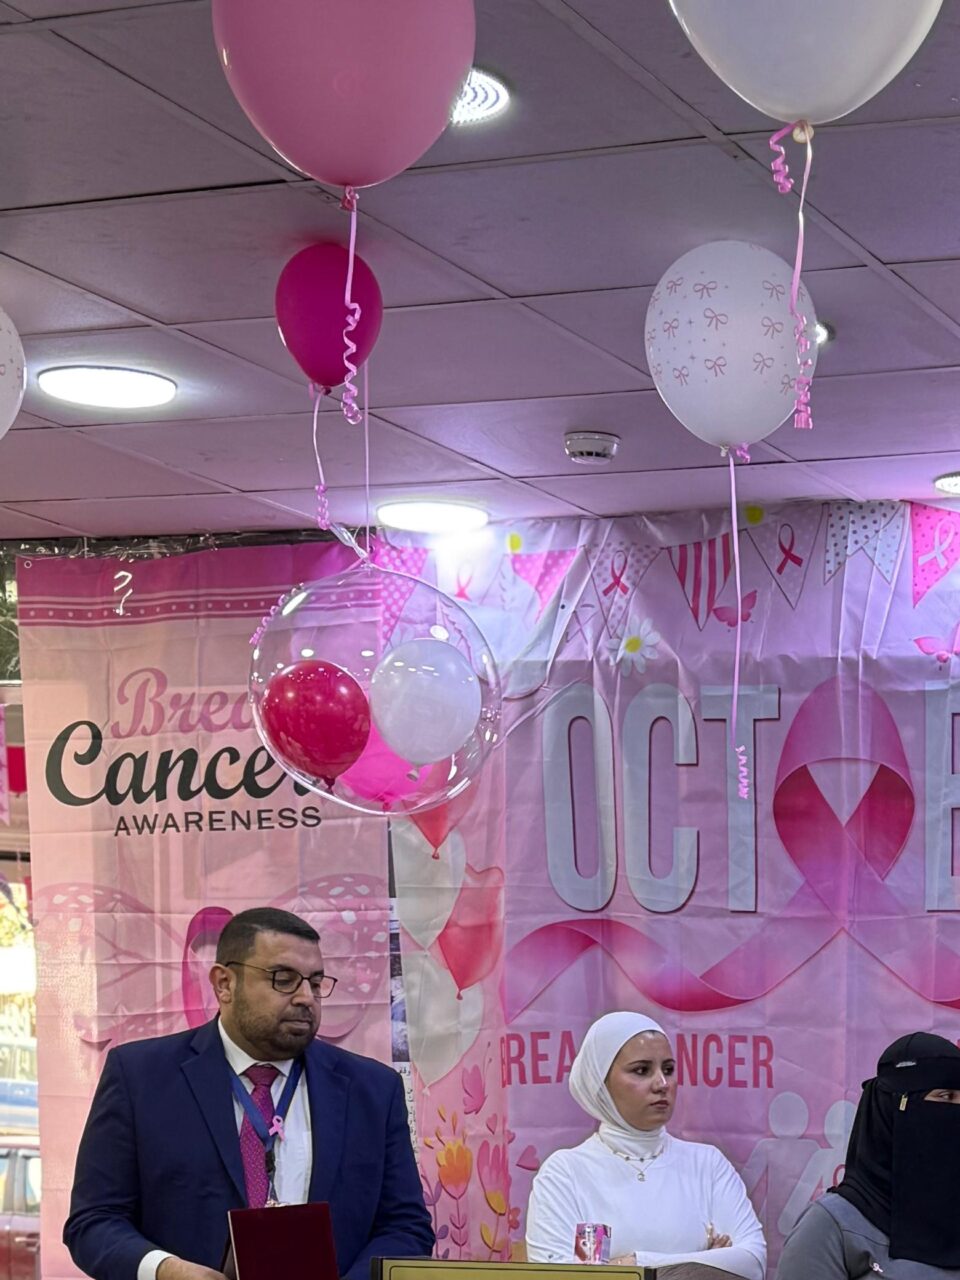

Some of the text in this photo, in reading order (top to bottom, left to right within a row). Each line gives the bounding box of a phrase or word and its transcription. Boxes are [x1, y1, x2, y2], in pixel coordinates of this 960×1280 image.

[45, 720, 311, 807] Cance
[114, 806, 322, 837] AWARENESS
[676, 1033, 774, 1089] NCER
